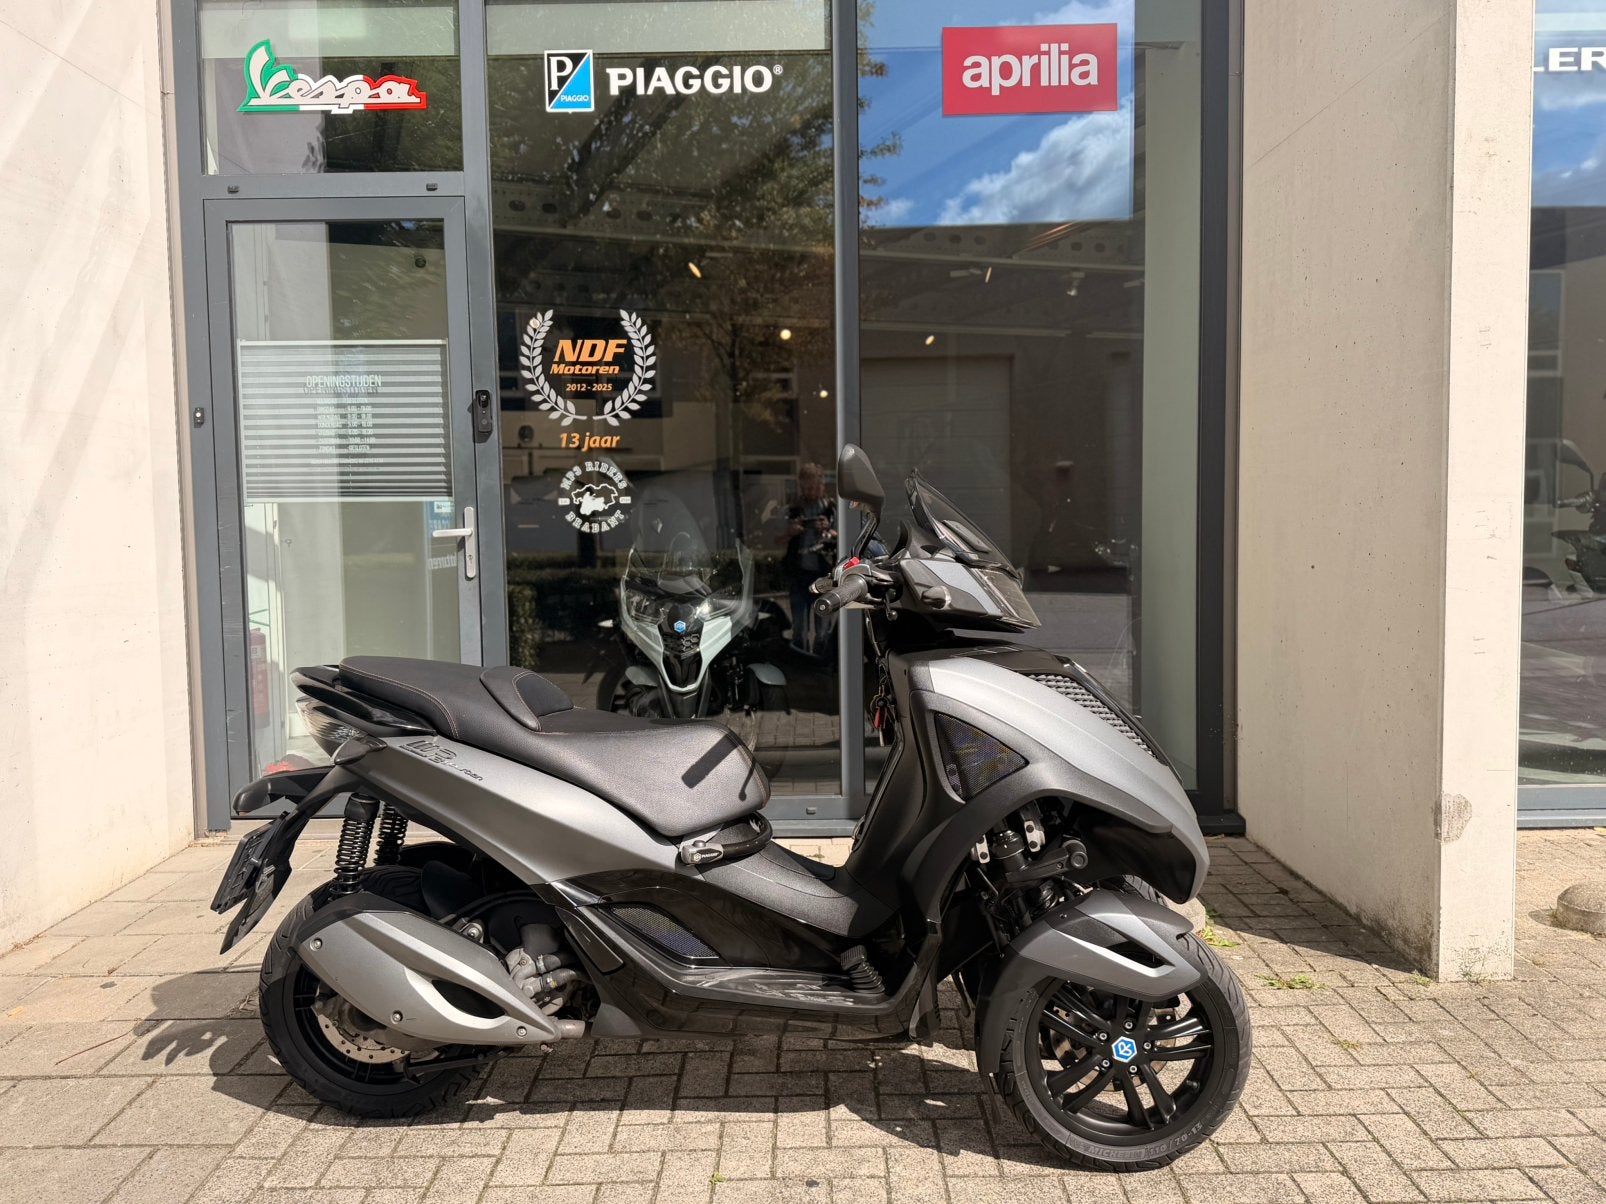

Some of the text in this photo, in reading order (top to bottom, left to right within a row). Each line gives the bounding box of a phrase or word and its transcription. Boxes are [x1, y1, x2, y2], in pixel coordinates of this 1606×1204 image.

[246, 43, 423, 110] Vespa
[549, 56, 573, 90] P
[962, 43, 1098, 95] aprilia
[561, 94, 589, 102] PIAGGIO
[553, 339, 627, 362] NDF
[550, 363, 620, 375] Motoren
[560, 432, 621, 452] 13 jaar
[560, 461, 628, 490] MP3 RIDERS
[565, 509, 625, 533] BRABANT
